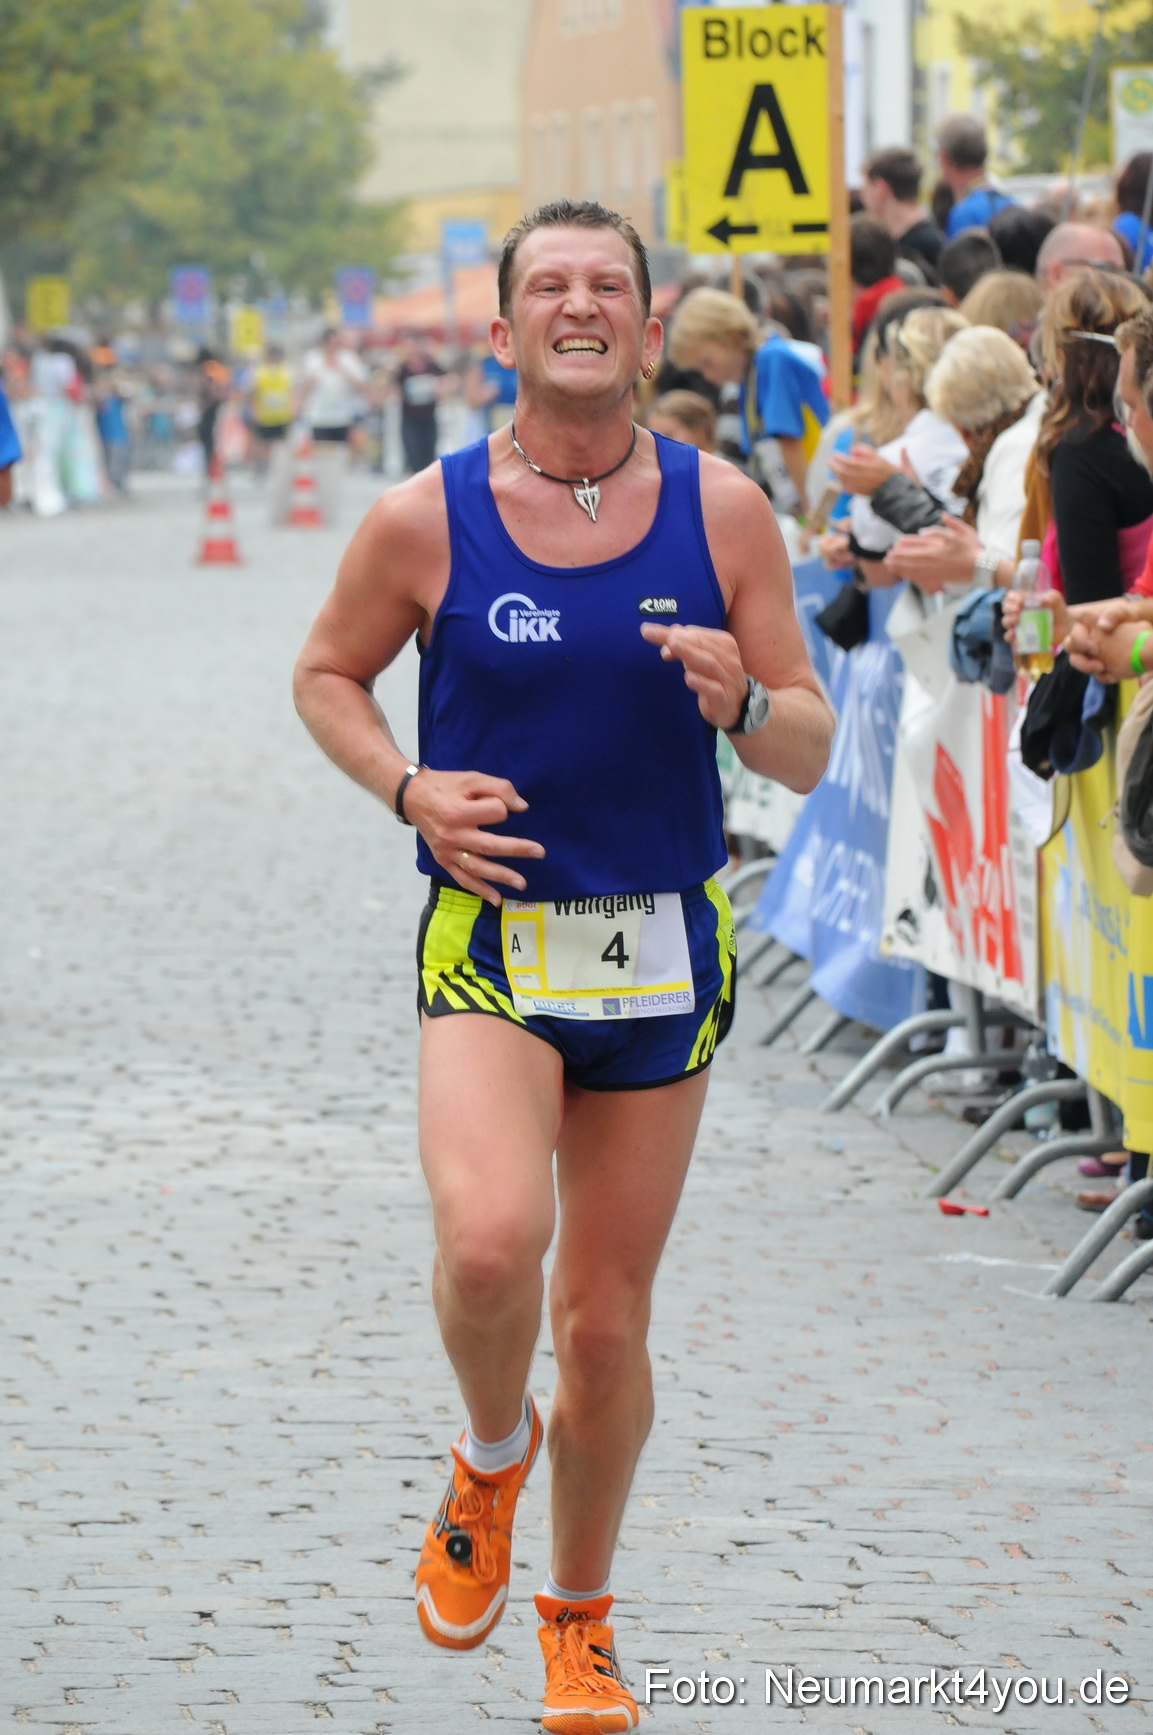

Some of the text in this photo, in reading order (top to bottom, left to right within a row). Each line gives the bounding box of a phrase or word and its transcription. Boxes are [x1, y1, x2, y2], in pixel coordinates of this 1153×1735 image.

[703, 16, 825, 58] Block
[724, 83, 809, 197] A
[511, 934, 522, 953] A
[601, 931, 630, 969] 4
[622, 991, 691, 1008] PFLEIDERER
